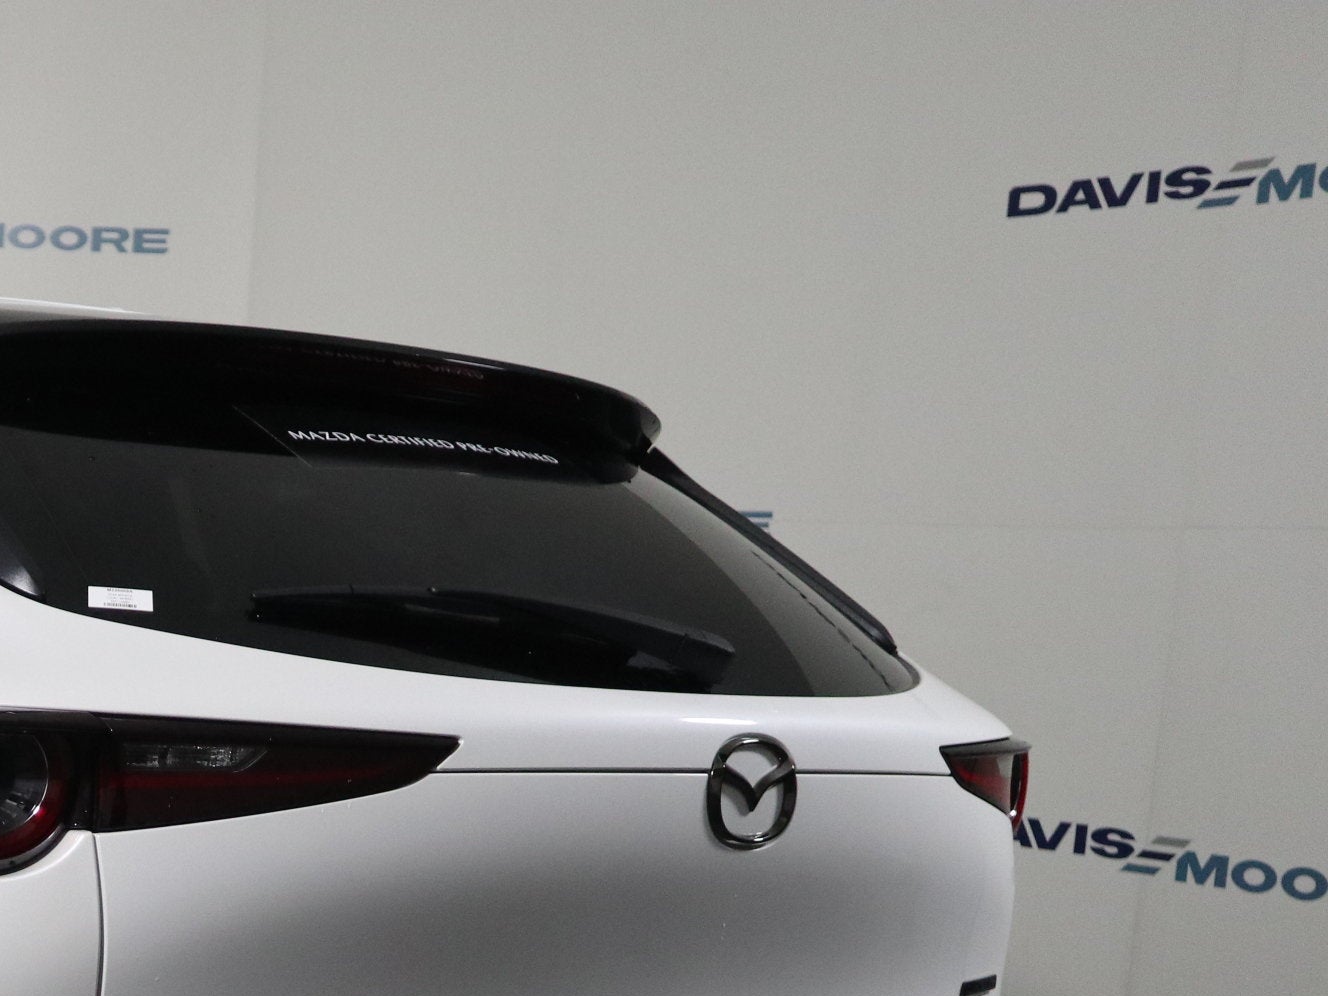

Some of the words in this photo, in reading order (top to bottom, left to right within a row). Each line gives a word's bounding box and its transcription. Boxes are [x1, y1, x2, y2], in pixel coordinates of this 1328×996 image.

[1006, 166, 1212, 218] DAVIS
[287, 430, 366, 442] MAZDA
[366, 433, 454, 449] CERTIFIED
